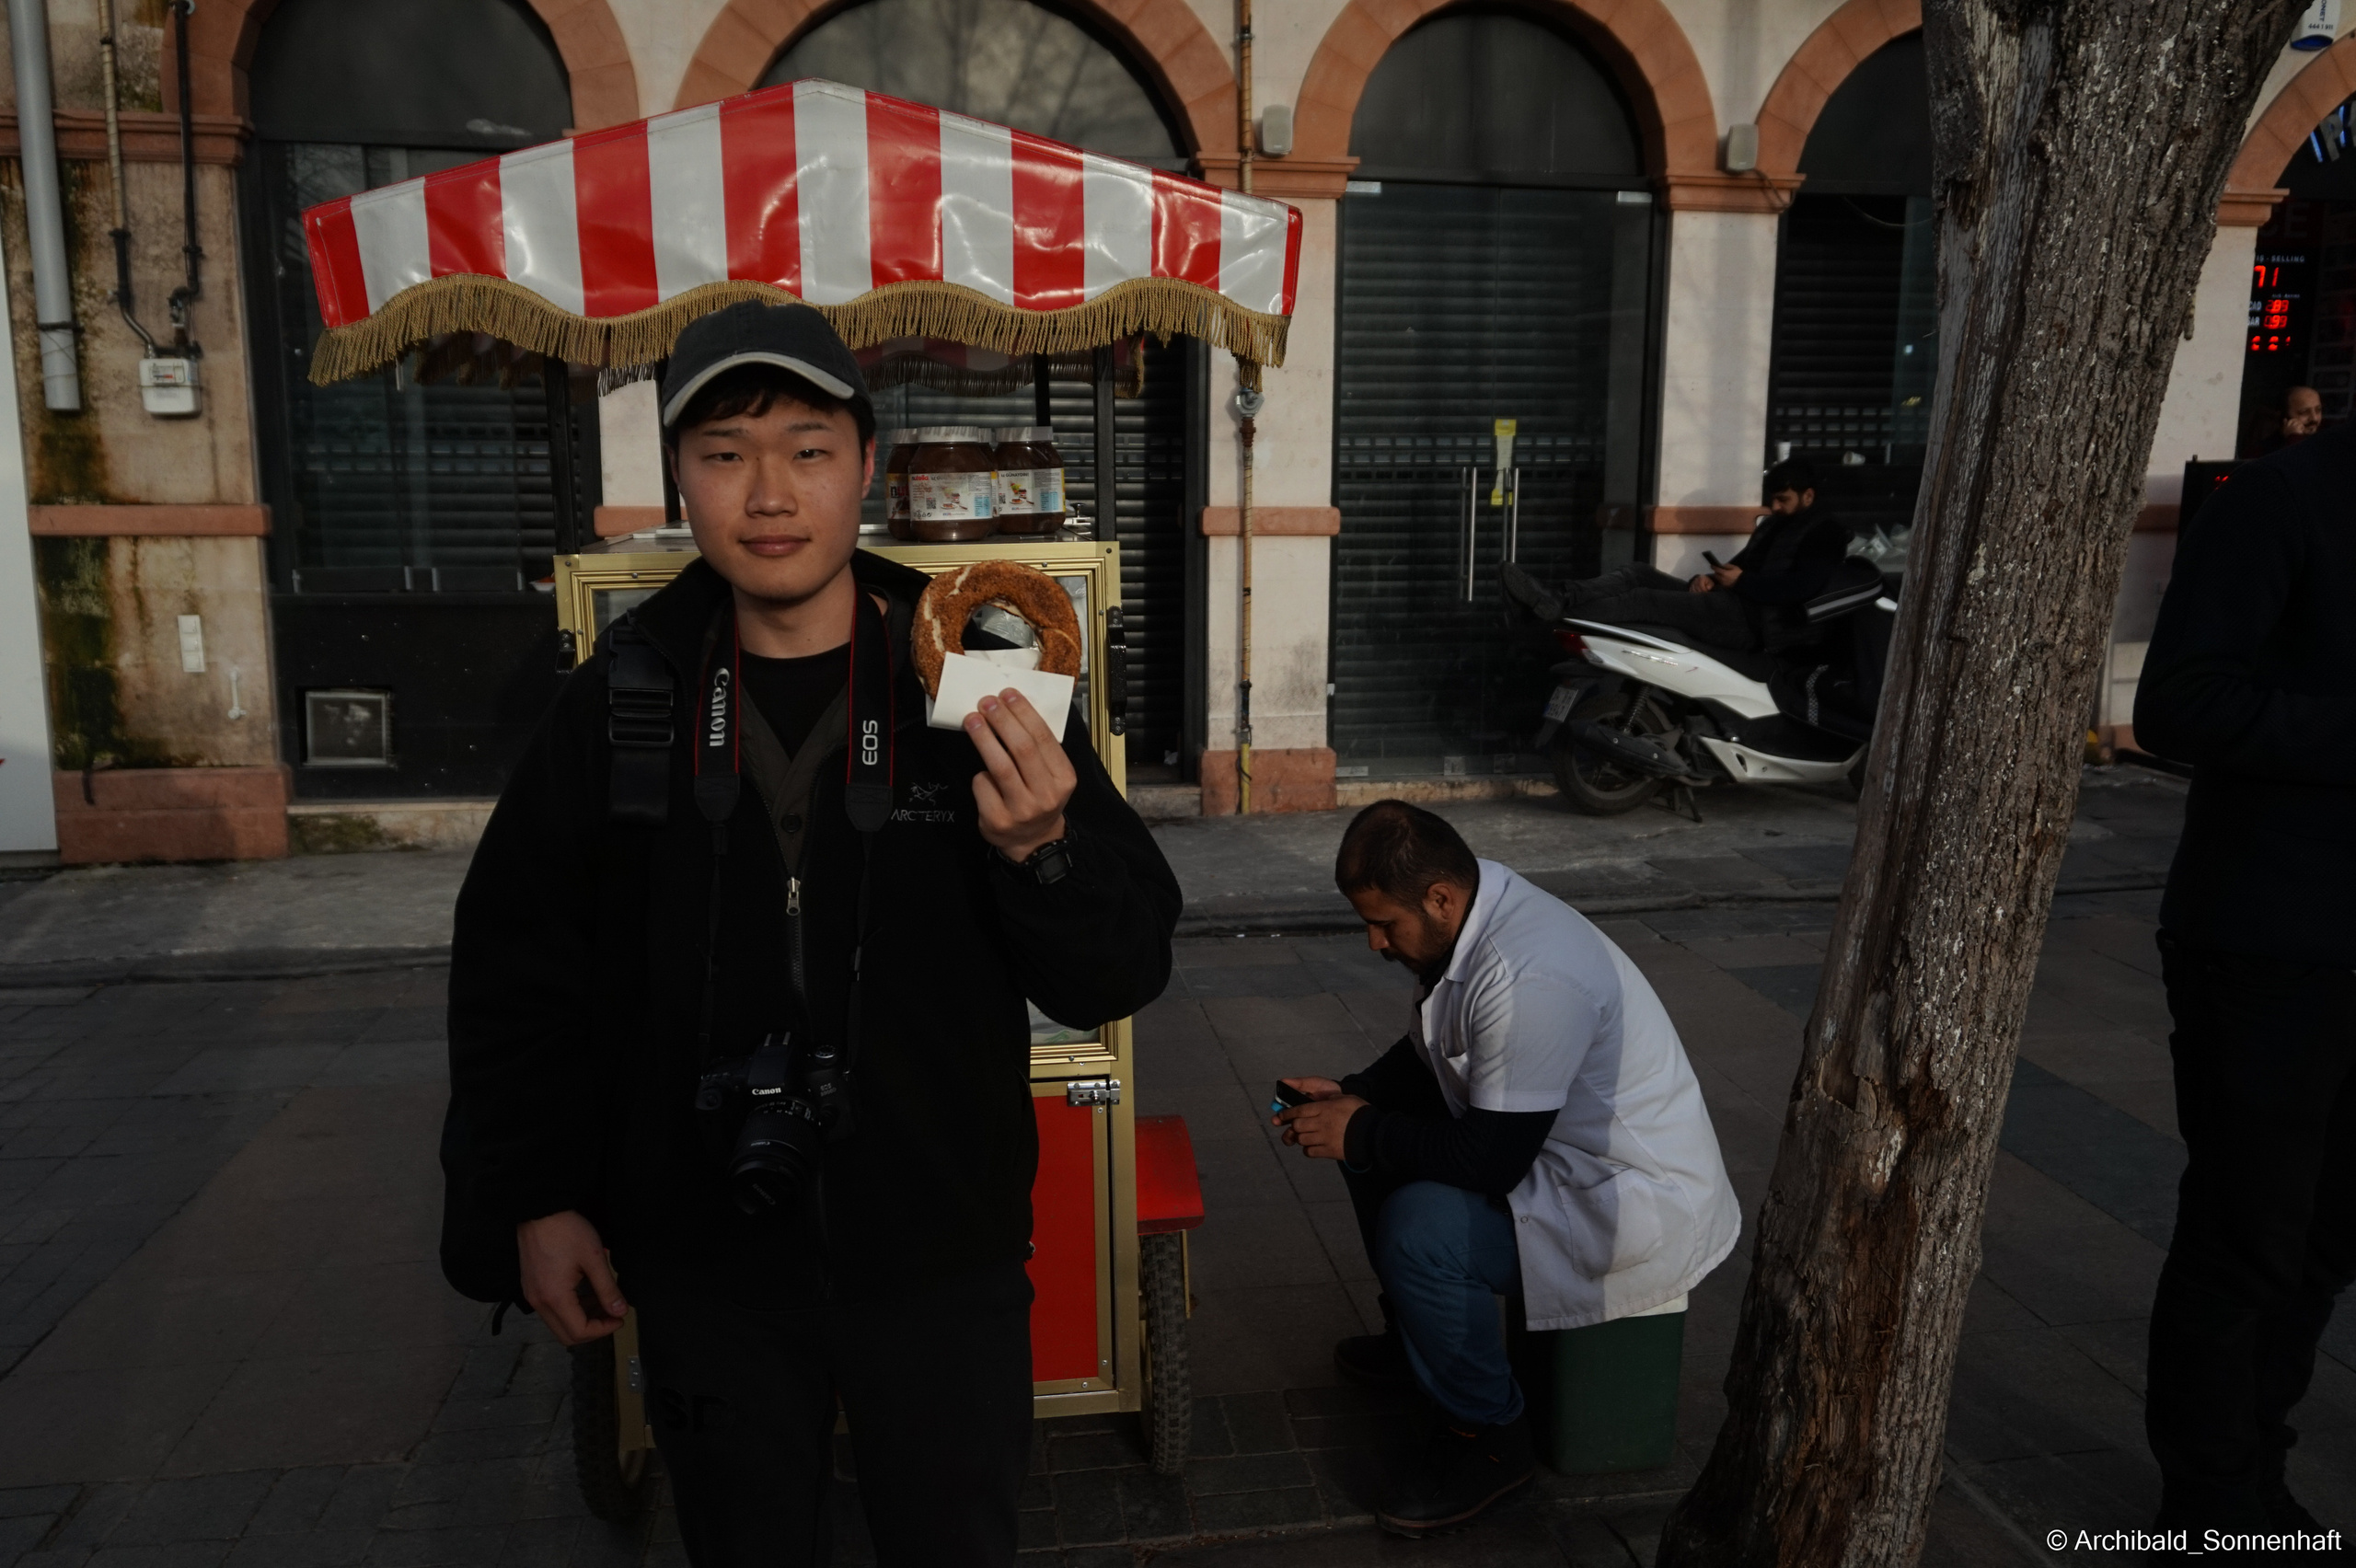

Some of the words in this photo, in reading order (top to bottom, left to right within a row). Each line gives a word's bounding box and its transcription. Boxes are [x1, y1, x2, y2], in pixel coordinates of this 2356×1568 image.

[2271, 254, 2305, 263] SELLING
[709, 666, 731, 747] Canon
[861, 720, 879, 766] EOS
[751, 1087, 782, 1096] Canon
